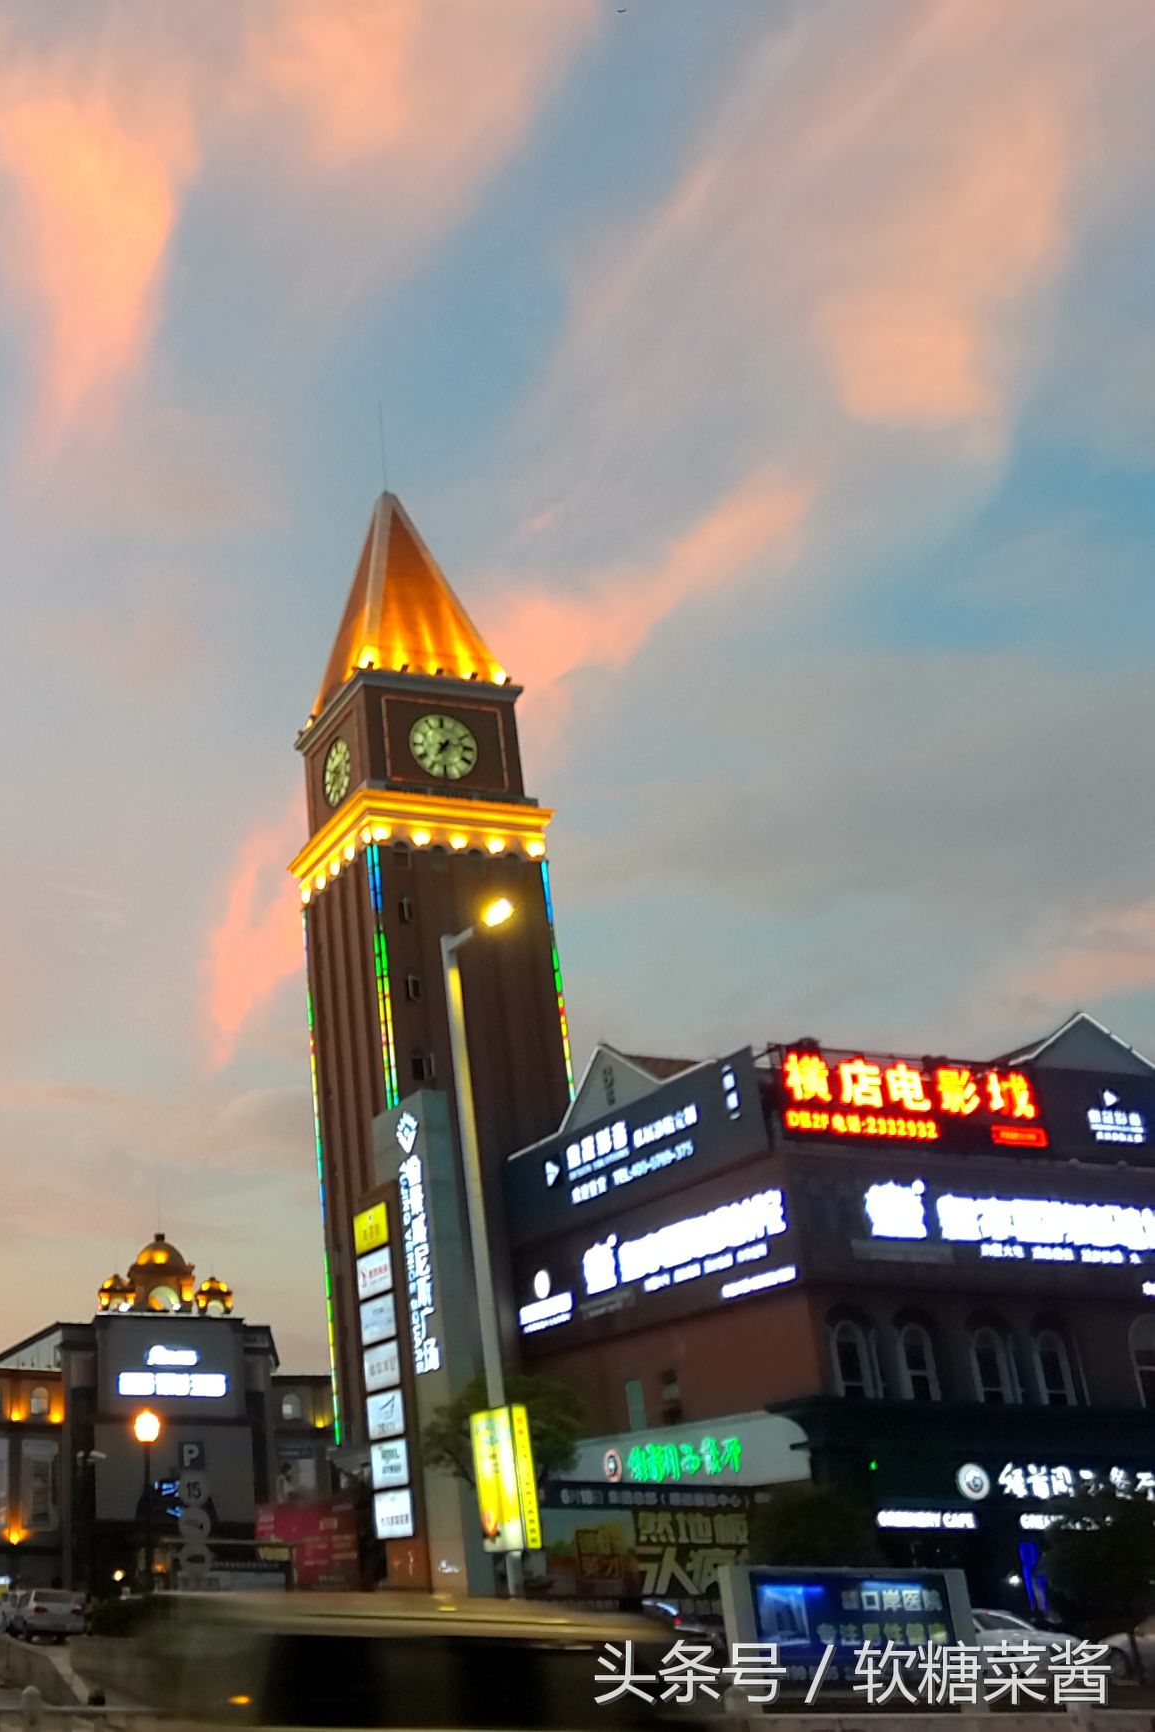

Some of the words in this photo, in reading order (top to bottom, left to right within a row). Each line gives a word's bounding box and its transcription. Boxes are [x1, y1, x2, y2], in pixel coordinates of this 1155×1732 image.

[785, 1053, 1037, 1120] 横店电影城
[183, 1444, 200, 1467] P
